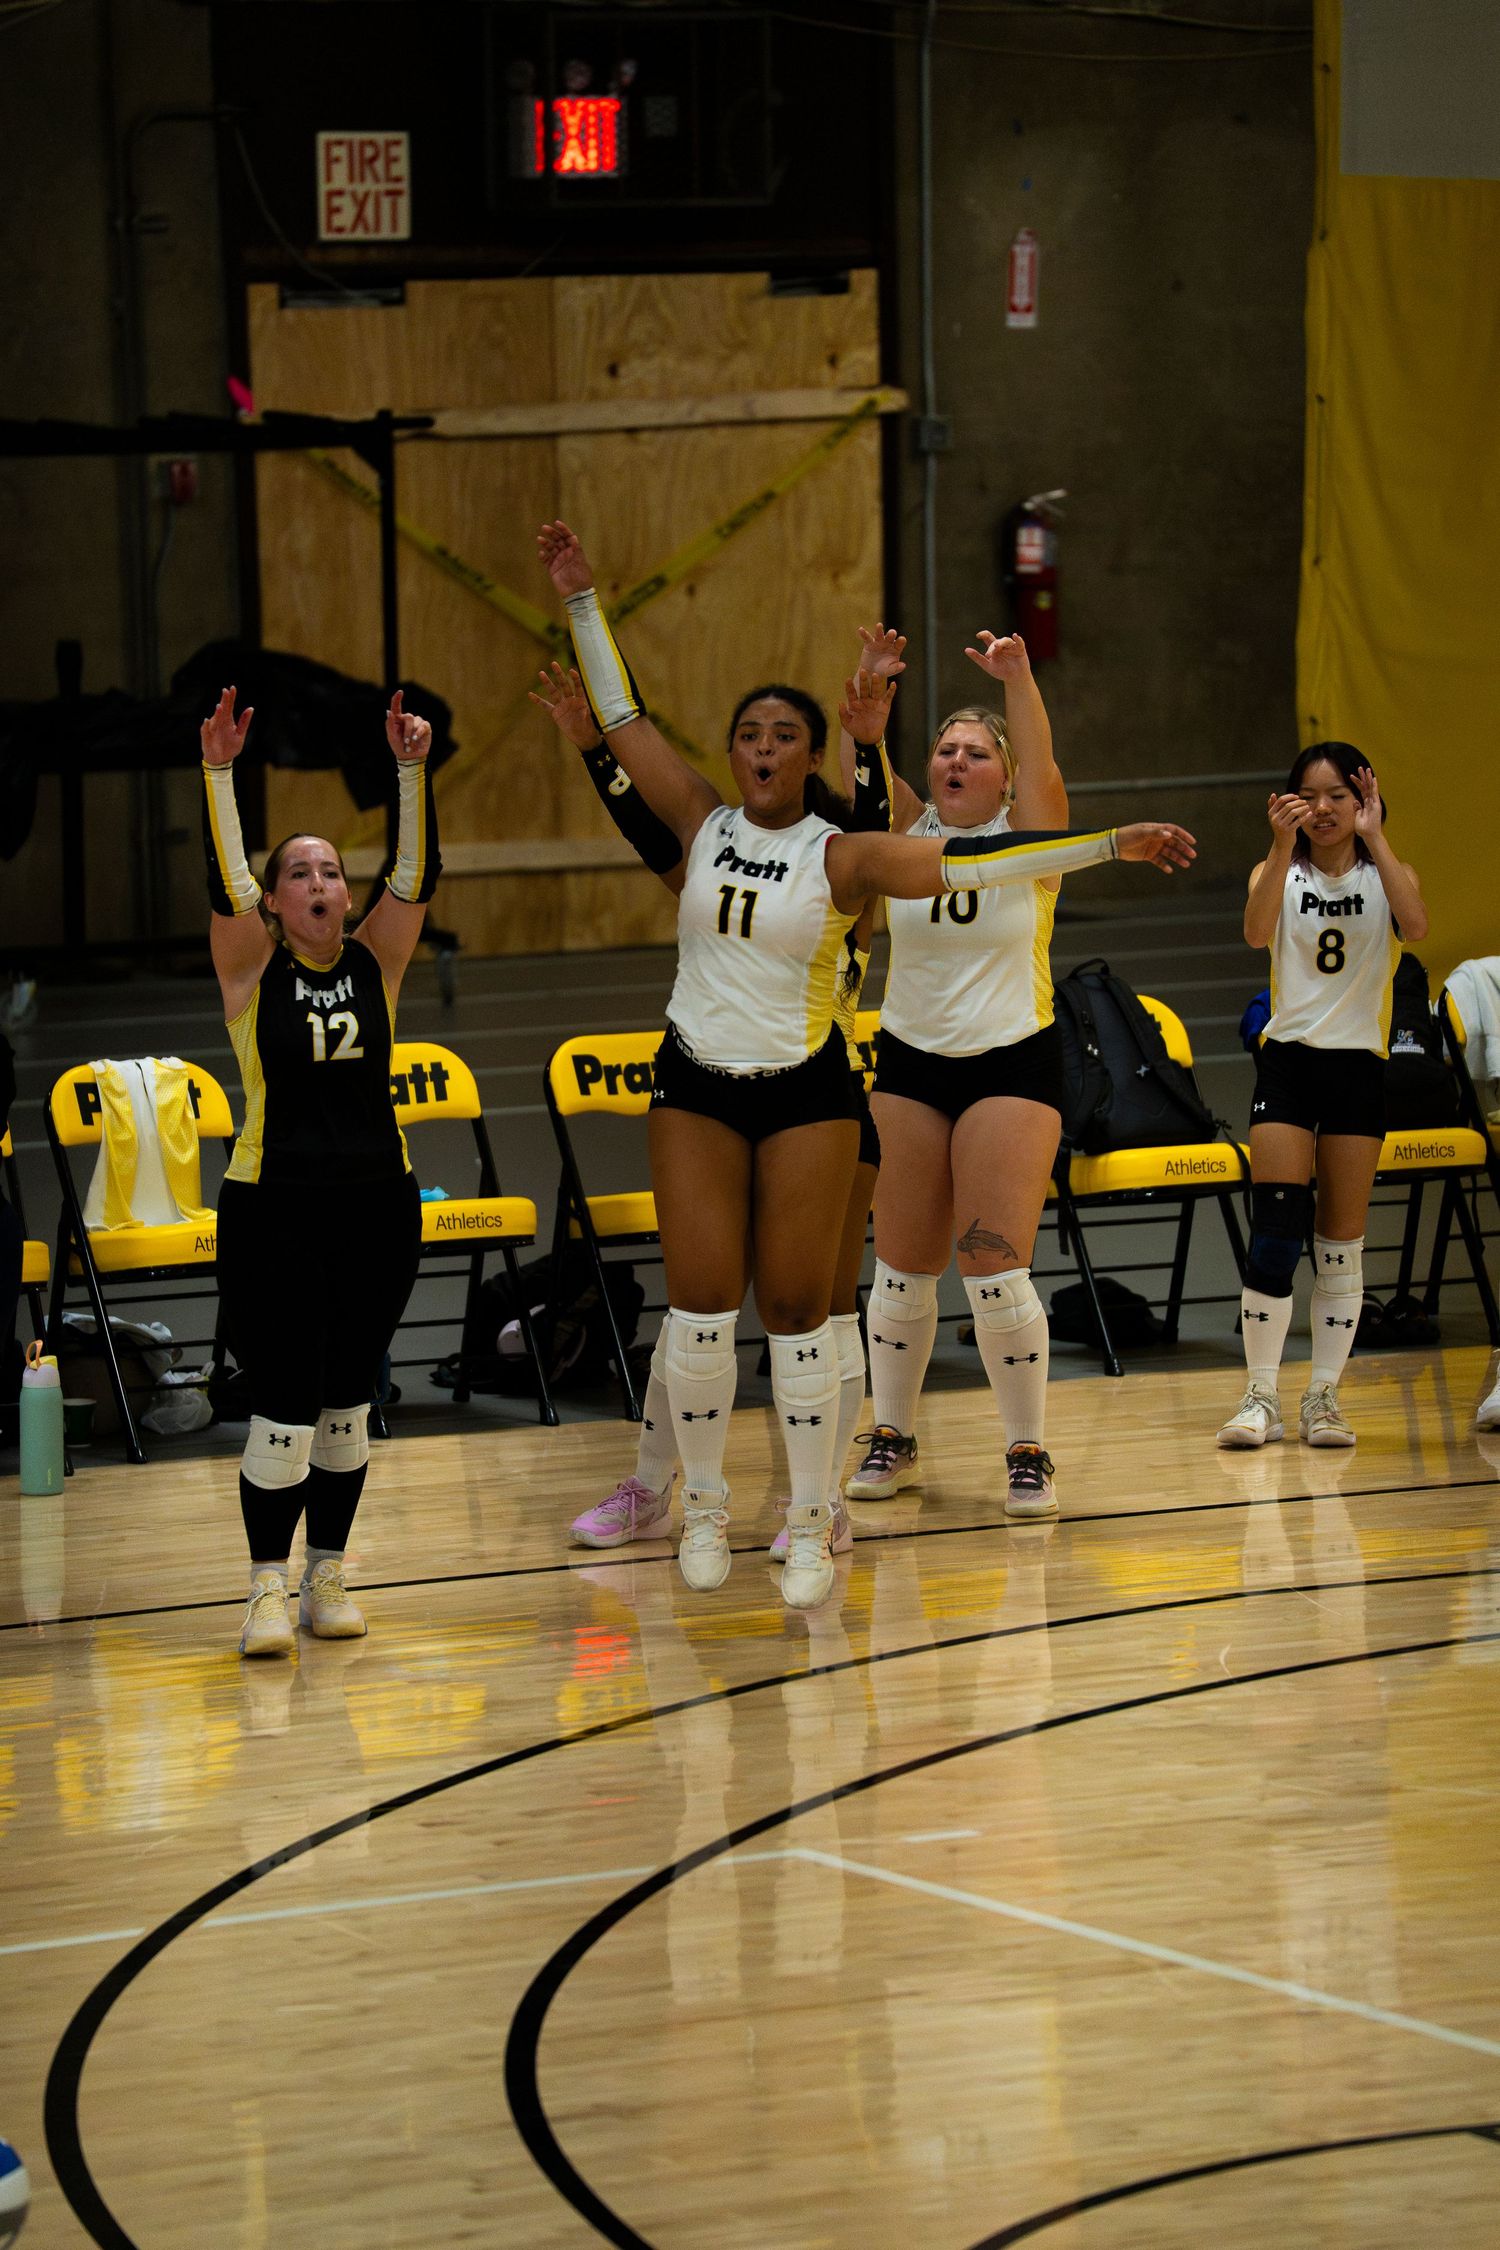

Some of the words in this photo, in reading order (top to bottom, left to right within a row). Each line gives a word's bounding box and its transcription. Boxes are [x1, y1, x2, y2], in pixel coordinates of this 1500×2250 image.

[325, 140, 403, 183] FIRE
[325, 190, 404, 233] EXIT
[714, 845, 788, 882] Pratt
[718, 884, 758, 938] 11
[1300, 892, 1364, 917] Pratt
[1316, 929, 1345, 974] 8
[295, 974, 355, 1010] Pratt
[306, 1010, 365, 1062] 12
[391, 1061, 450, 1106] att
[572, 1053, 659, 1096] Pra
[1165, 1158, 1227, 1176] Athletics
[1393, 1143, 1455, 1160] Athletics
[435, 1211, 504, 1232] Athletics
